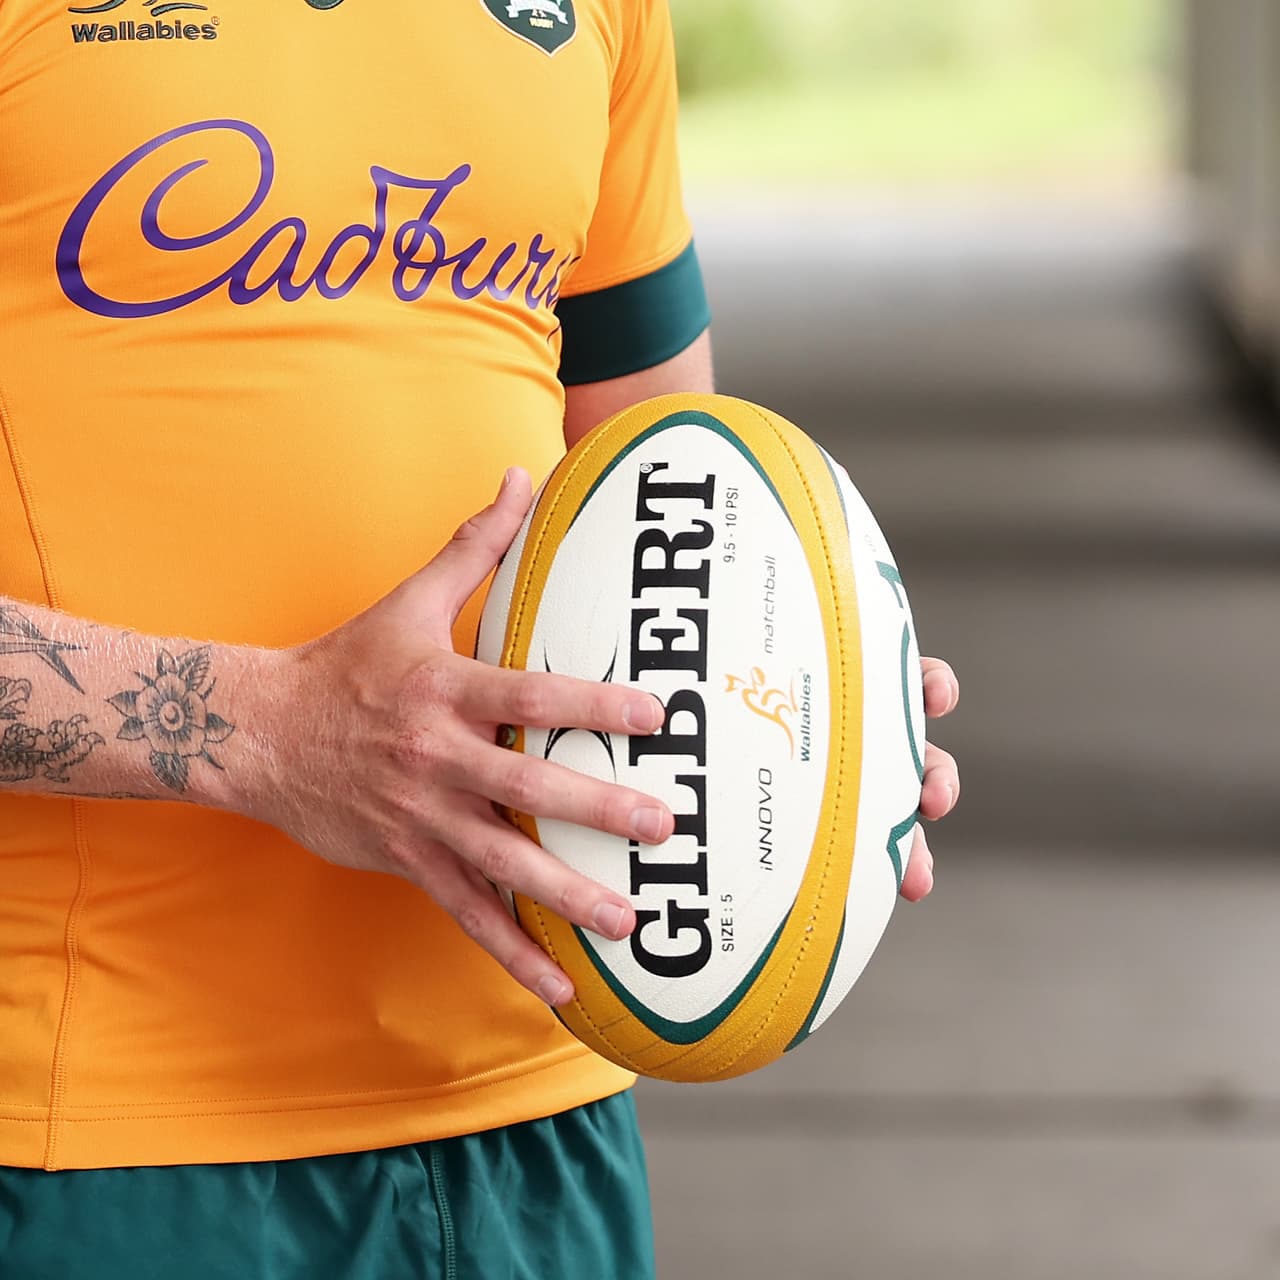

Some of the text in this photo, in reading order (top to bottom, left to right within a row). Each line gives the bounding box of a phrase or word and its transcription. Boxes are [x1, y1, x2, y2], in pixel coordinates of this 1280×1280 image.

[71, 20, 218, 43] Wallabies
[725, 487, 739, 509] PSI
[725, 512, 738, 528] 10
[723, 542, 736, 563] 9.5
[763, 555, 776, 655] matchball
[628, 461, 716, 979] GILBERT
[800, 673, 812, 762] Wallabies
[720, 893, 733, 903] 5
[721, 917, 734, 952] SIZE
